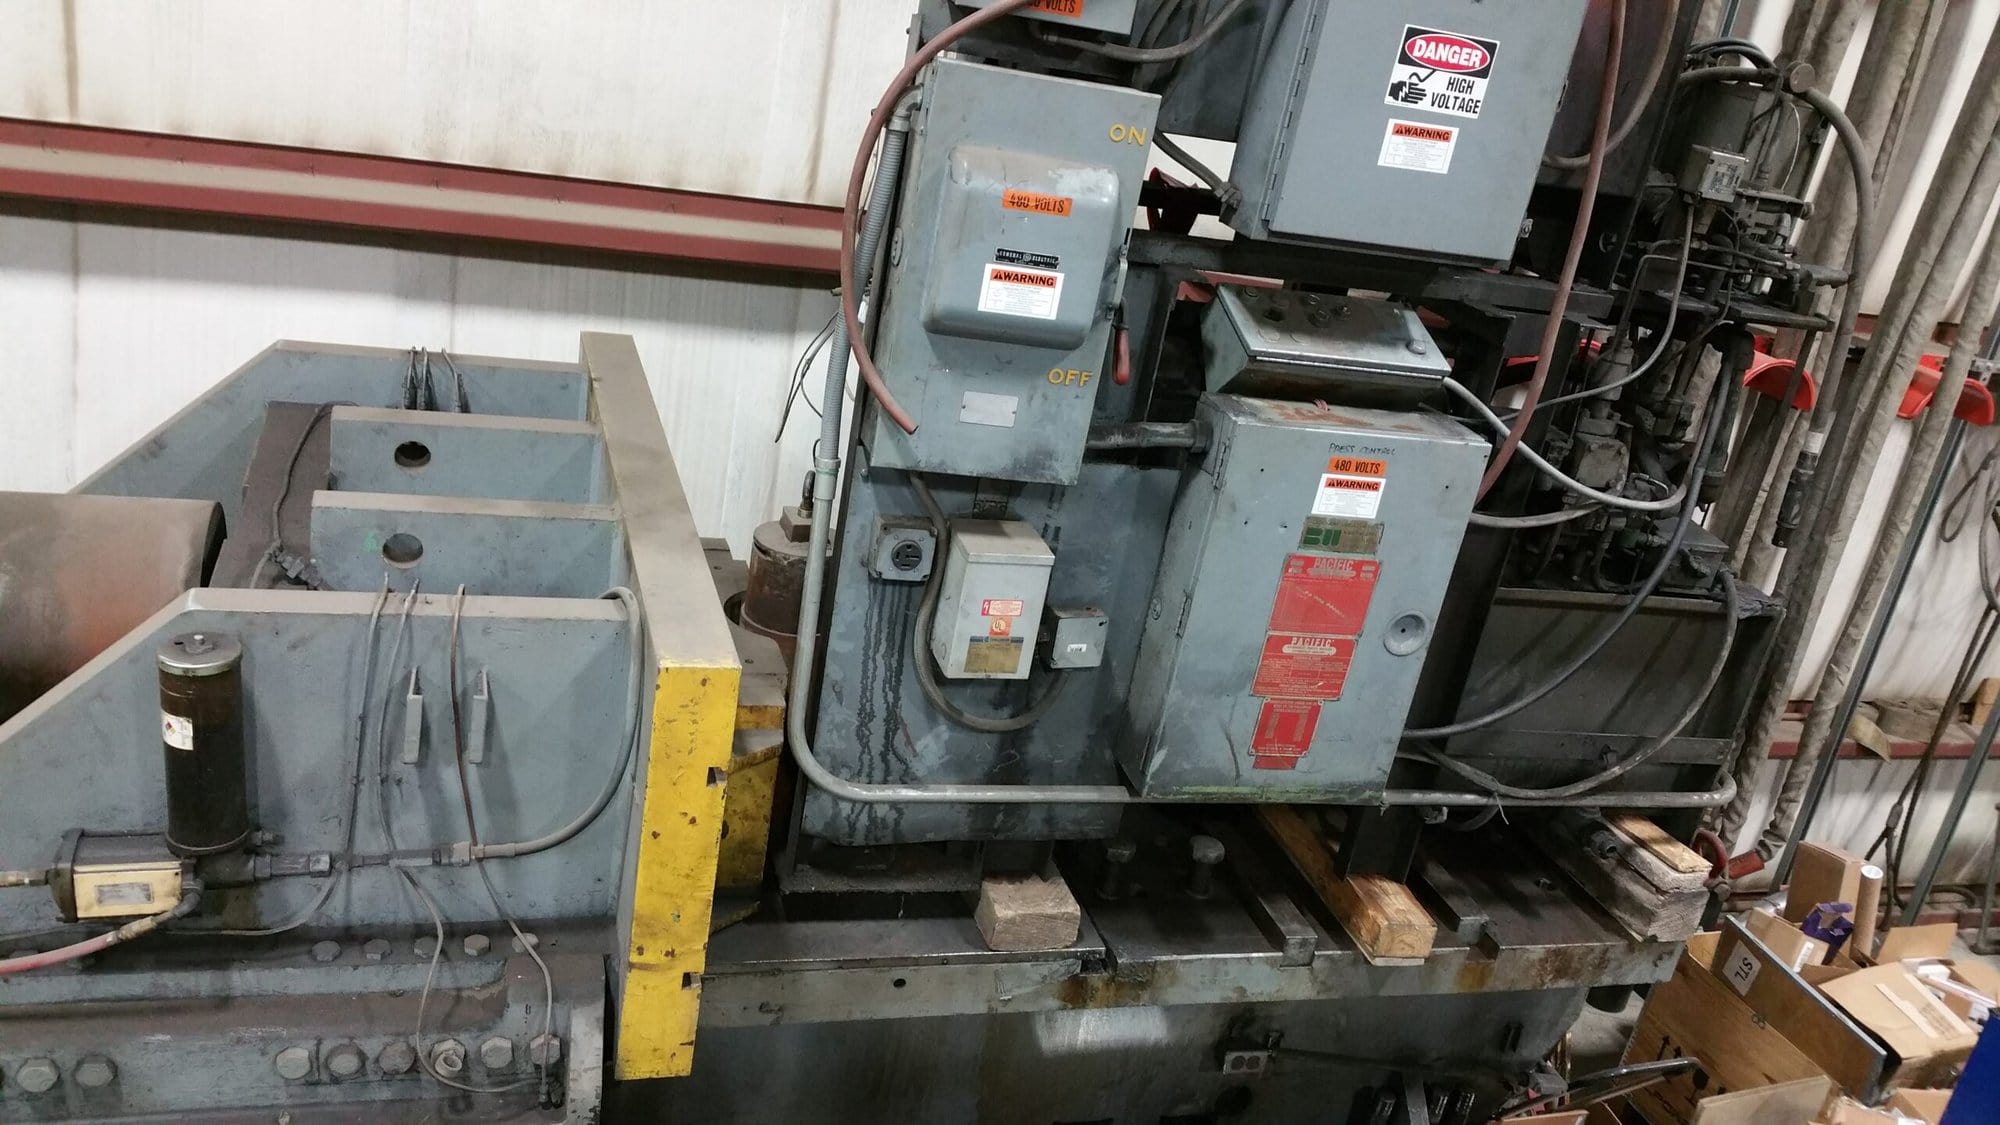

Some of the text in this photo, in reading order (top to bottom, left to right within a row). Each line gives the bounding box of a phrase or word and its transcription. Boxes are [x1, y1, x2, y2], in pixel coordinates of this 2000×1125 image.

[1045, 0, 1076, 14] VOLTS
[1413, 38, 1483, 68] DANGER
[1446, 76, 1475, 95] HIGH
[1431, 91, 1481, 114] VOLTAGE
[1110, 124, 1147, 146] ON
[1403, 126, 1450, 141] WARNING
[1009, 193, 1065, 213] 480 VOLTS
[1003, 272, 1054, 287] WARNING
[1047, 367, 1093, 387] OFF
[1328, 442, 1355, 454] PRESS
[1334, 459, 1381, 475] 480 VOLTS
[1335, 480, 1379, 491] WARNING
[1314, 557, 1354, 571] PACIFIC
[1290, 637, 1332, 647] PACIFIC
[1734, 957, 1754, 982] STL
